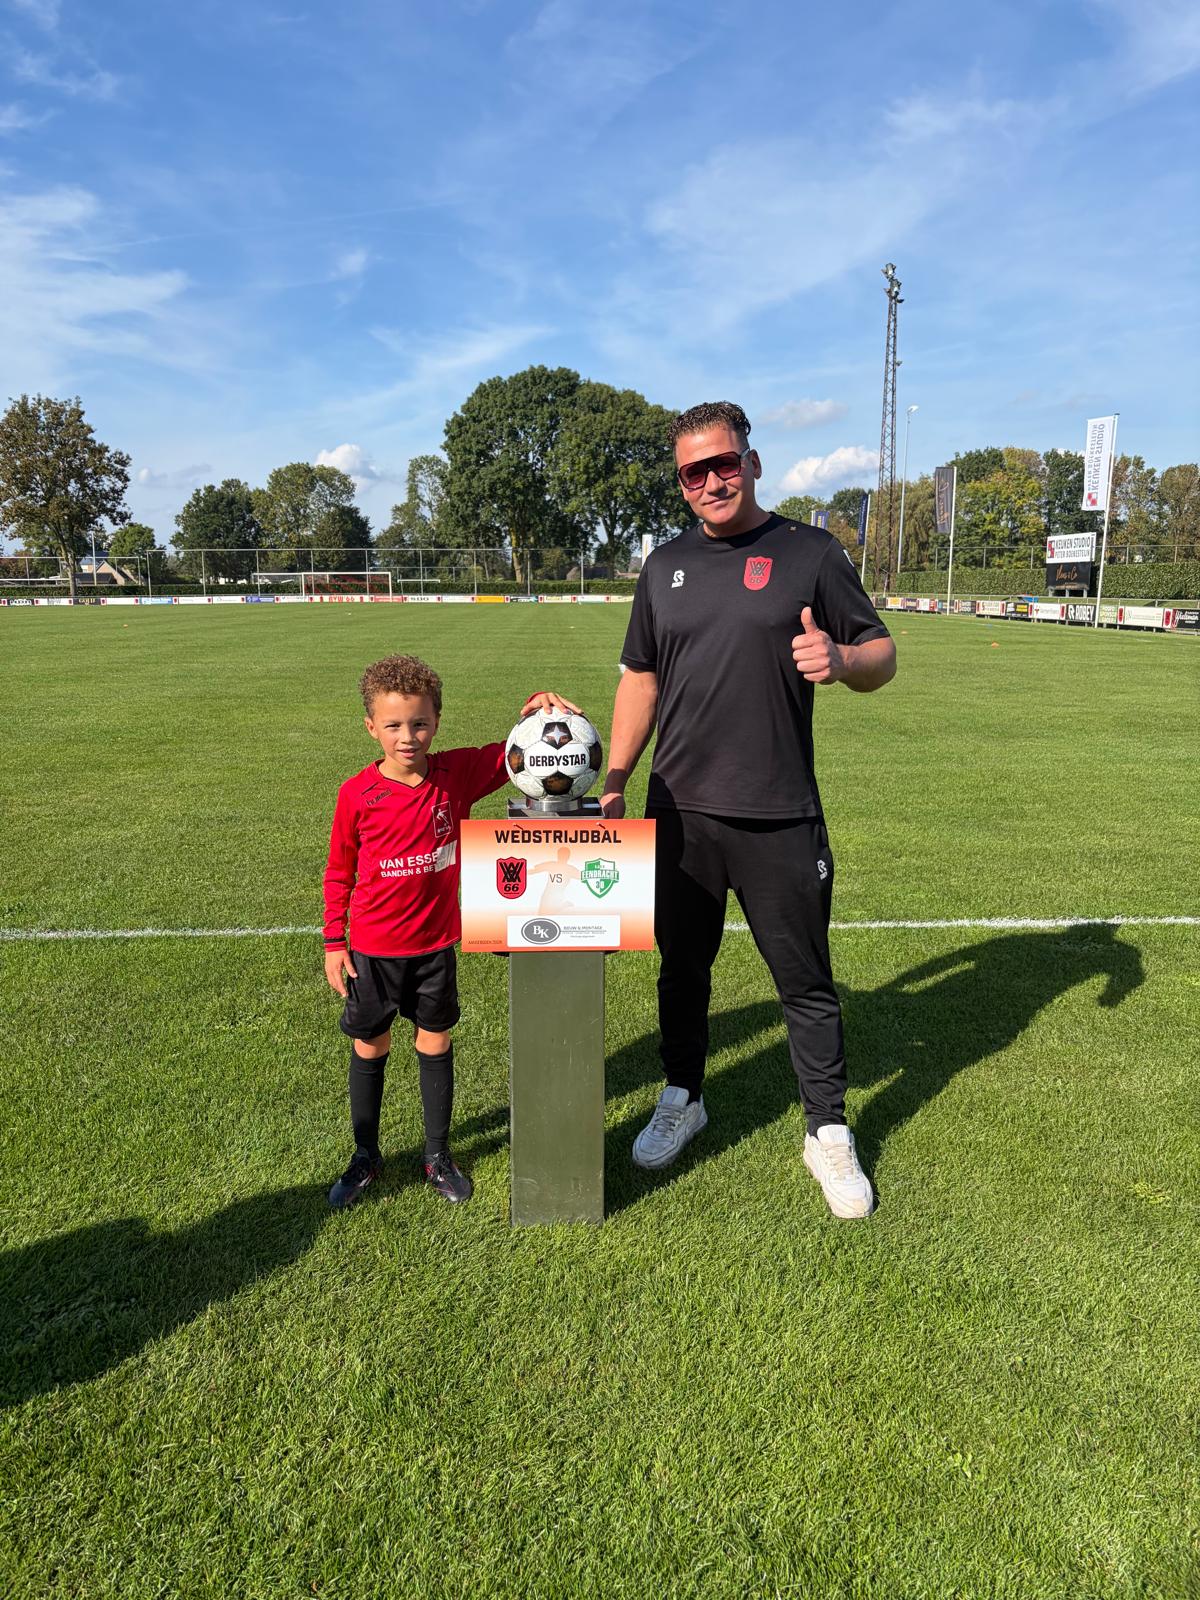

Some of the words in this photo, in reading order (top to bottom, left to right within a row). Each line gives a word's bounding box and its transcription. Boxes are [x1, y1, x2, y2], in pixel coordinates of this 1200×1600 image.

[1055, 539, 1073, 550] KEUKEN
[1073, 536, 1091, 549] STUDIO
[1075, 604, 1094, 621] ROBEY
[529, 753, 586, 767] DERBYSTAR
[495, 830, 621, 844] WEDSTRIJDBAL
[379, 858, 404, 869] VAN
[407, 851, 438, 867] ESSE
[380, 867, 414, 878] BANDEN
[415, 867, 422, 875] &
[423, 864, 435, 873] BE
[549, 873, 563, 884] VS
[595, 880, 605, 889] 30
[504, 884, 519, 892] 66
[533, 925, 549, 938] BK
